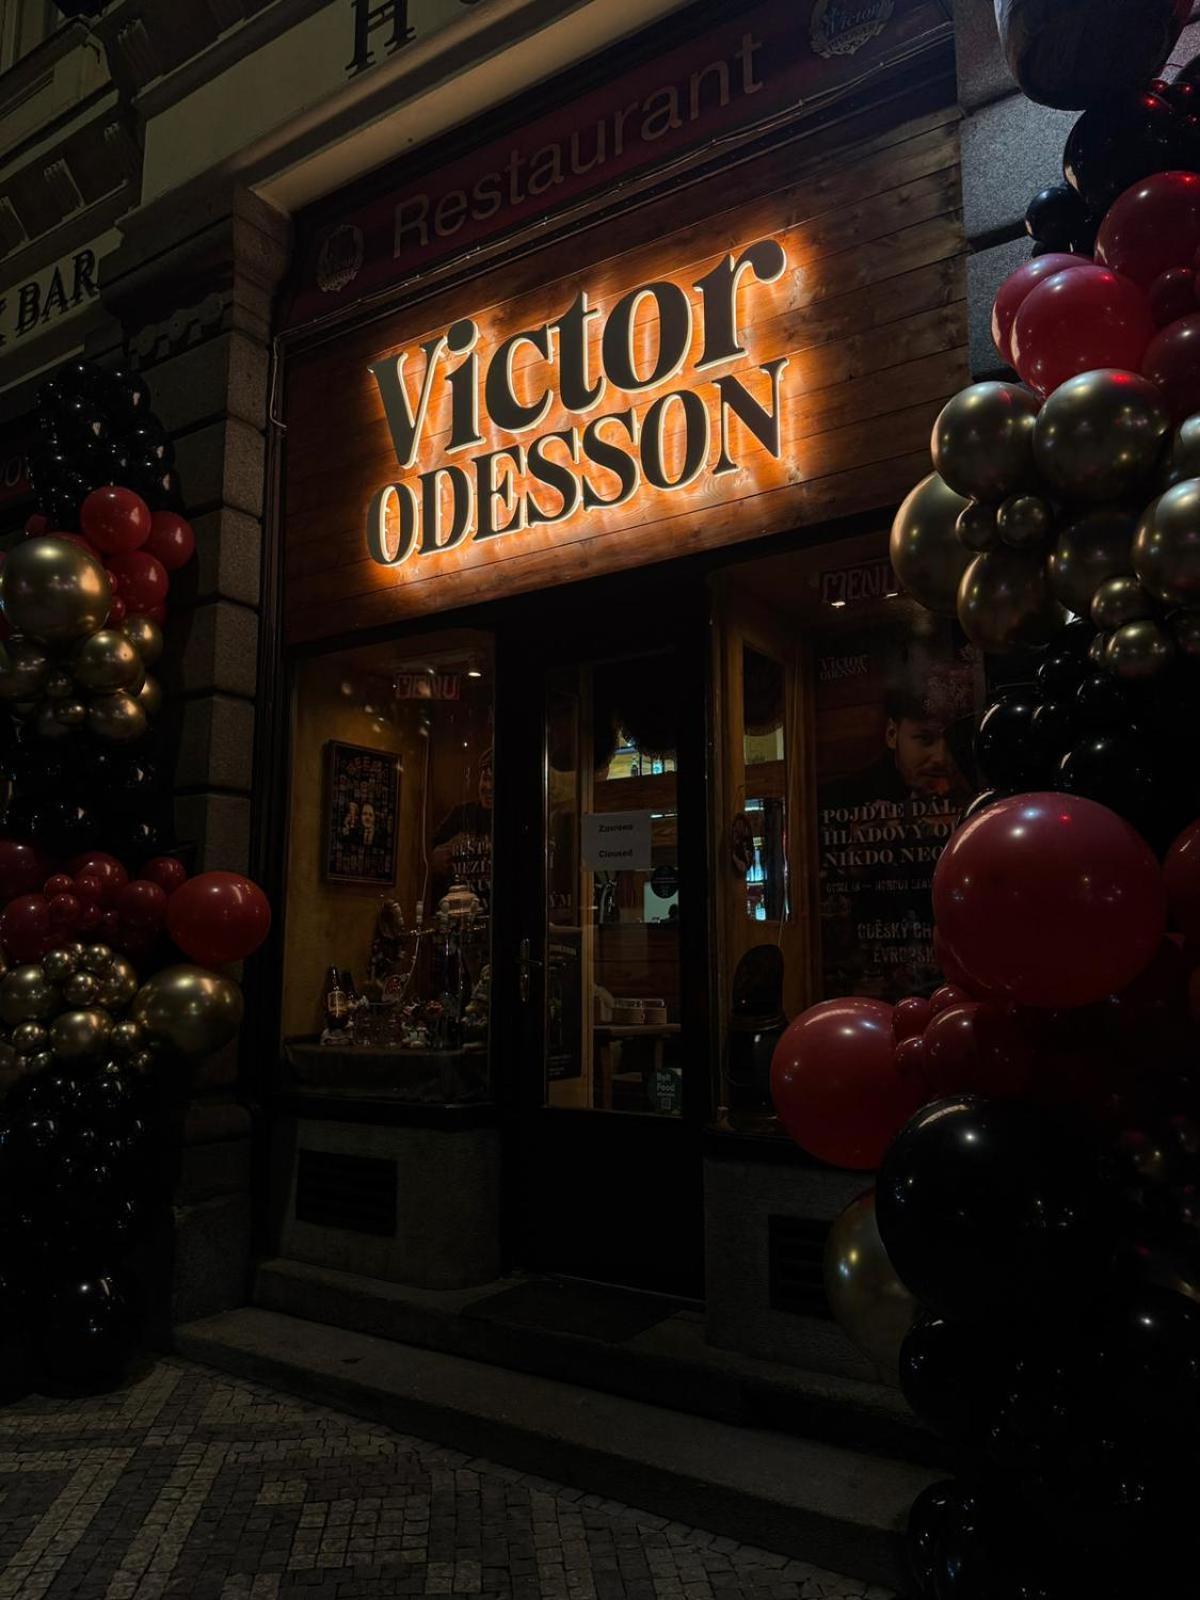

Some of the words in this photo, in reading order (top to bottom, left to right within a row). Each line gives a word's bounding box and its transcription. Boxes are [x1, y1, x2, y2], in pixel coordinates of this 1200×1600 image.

[393, 32, 764, 258] Restaurant
[16, 249, 99, 338] BAR
[367, 238, 788, 470] Victor
[366, 356, 790, 568] ODESSON
[822, 848, 893, 868] NIKDO
